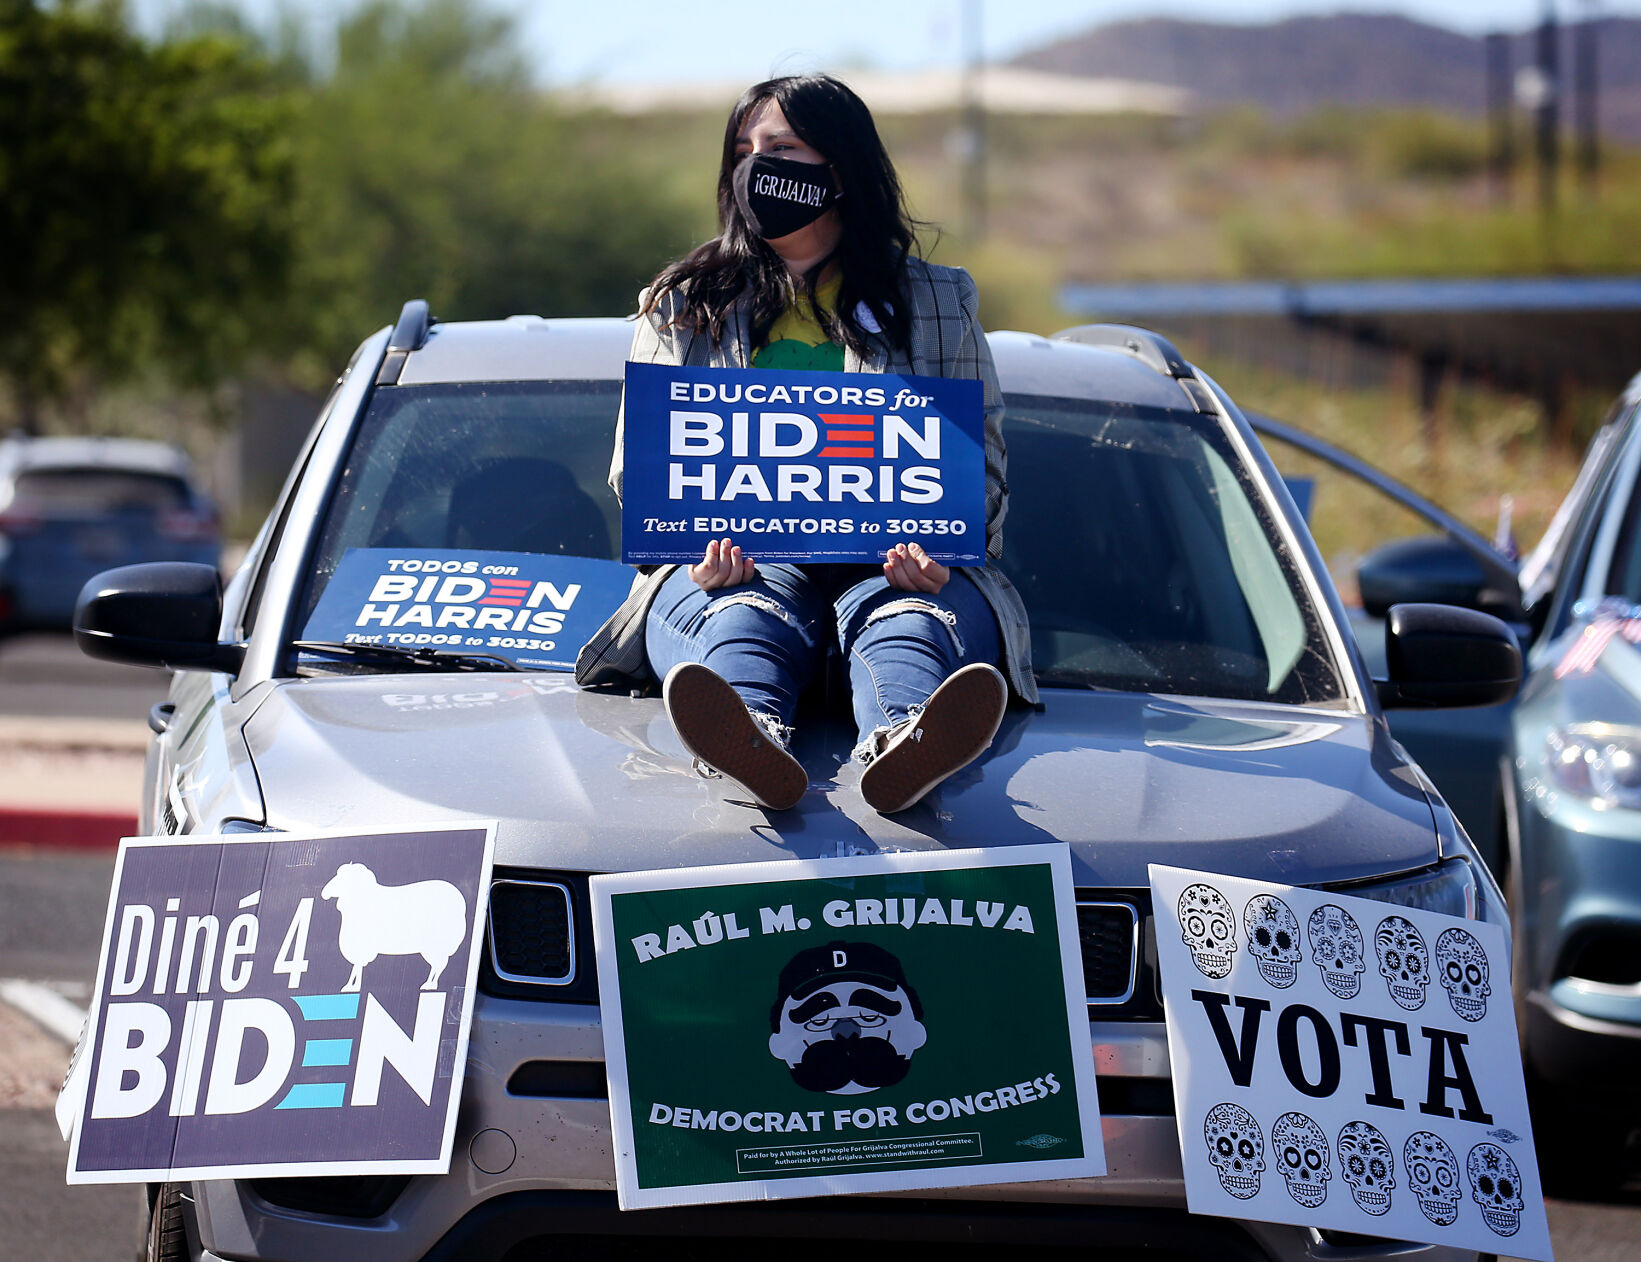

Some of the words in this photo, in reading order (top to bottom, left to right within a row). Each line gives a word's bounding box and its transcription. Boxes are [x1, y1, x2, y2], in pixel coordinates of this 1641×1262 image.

[754, 173, 827, 207] ¡GRIJALVA!
[670, 381, 886, 406] EDUCATORS
[889, 388, 935, 411] for
[669, 410, 941, 461] BIDEN
[668, 463, 944, 504] HARRIS
[643, 518, 688, 532] Text
[693, 517, 855, 534] EDUCATORS
[860, 520, 881, 534] to
[886, 519, 967, 535] 30330
[387, 559, 479, 574] TODOS
[481, 564, 519, 577] con
[368, 575, 582, 611] BIDEN
[355, 604, 566, 634] HARRIS
[344, 633, 383, 644] Text
[386, 632, 463, 645] TODOS
[464, 636, 484, 646] to
[486, 636, 556, 651] 30330
[110, 889, 262, 996] Diné
[273, 897, 315, 989] 4
[631, 910, 750, 964] RAÚL
[758, 904, 812, 935] M.
[822, 897, 1035, 934] GRIJALVA
[832, 950, 847, 968] D
[90, 990, 447, 1120] BIDEN
[1190, 988, 1494, 1126] VOTA
[648, 1102, 825, 1133] DEMOCRAT
[833, 1106, 899, 1131] FOR
[906, 1072, 1061, 1124] CONGRESS
[770, 1151, 779, 1159] by
[827, 1146, 850, 1155] People
[862, 1144, 888, 1152] Grijalva
[888, 1140, 935, 1150] Congressional
[935, 1138, 974, 1146] Committee.
[775, 1157, 812, 1165] Authorized
[837, 1154, 865, 1162] Grijalva.
[865, 1148, 945, 1159] www.standwithraul.com
